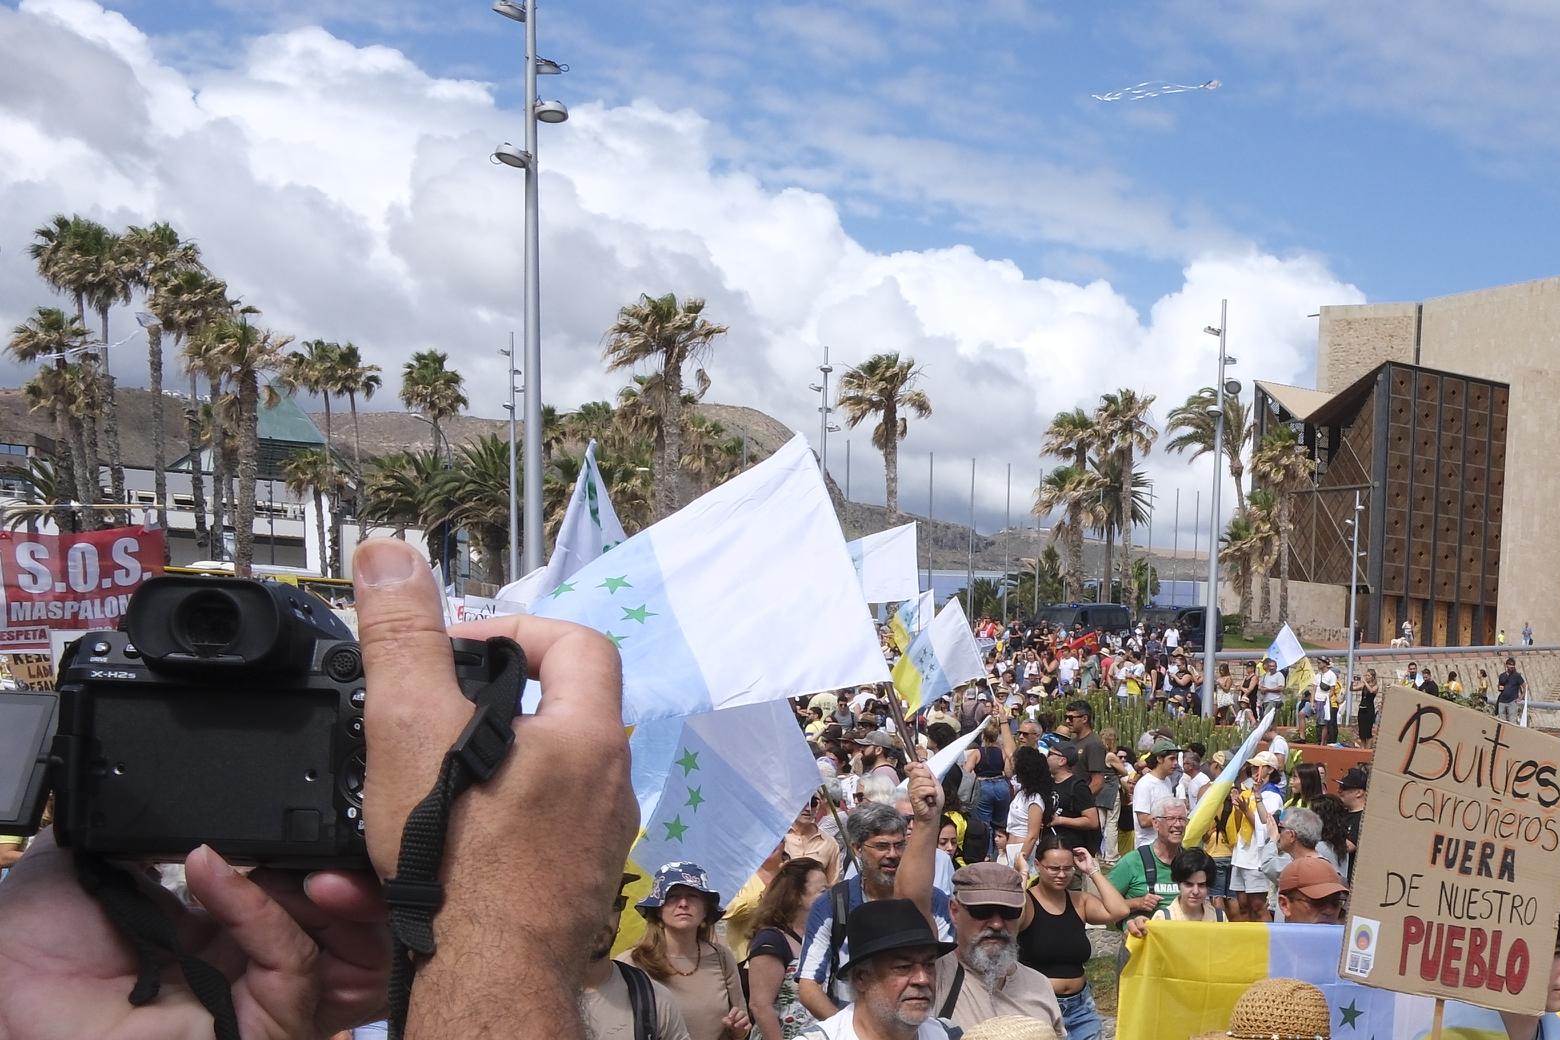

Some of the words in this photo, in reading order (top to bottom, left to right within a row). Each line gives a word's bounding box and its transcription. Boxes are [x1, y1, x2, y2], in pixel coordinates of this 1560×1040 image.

[16, 537, 152, 594] S.O.S.
[1399, 704, 1560, 808] Buitres
[1431, 835, 1516, 882] FUERA
[1380, 871, 1423, 908] DE
[1438, 881, 1538, 925] NUESTRO
[1399, 915, 1530, 995] PUEBLO
